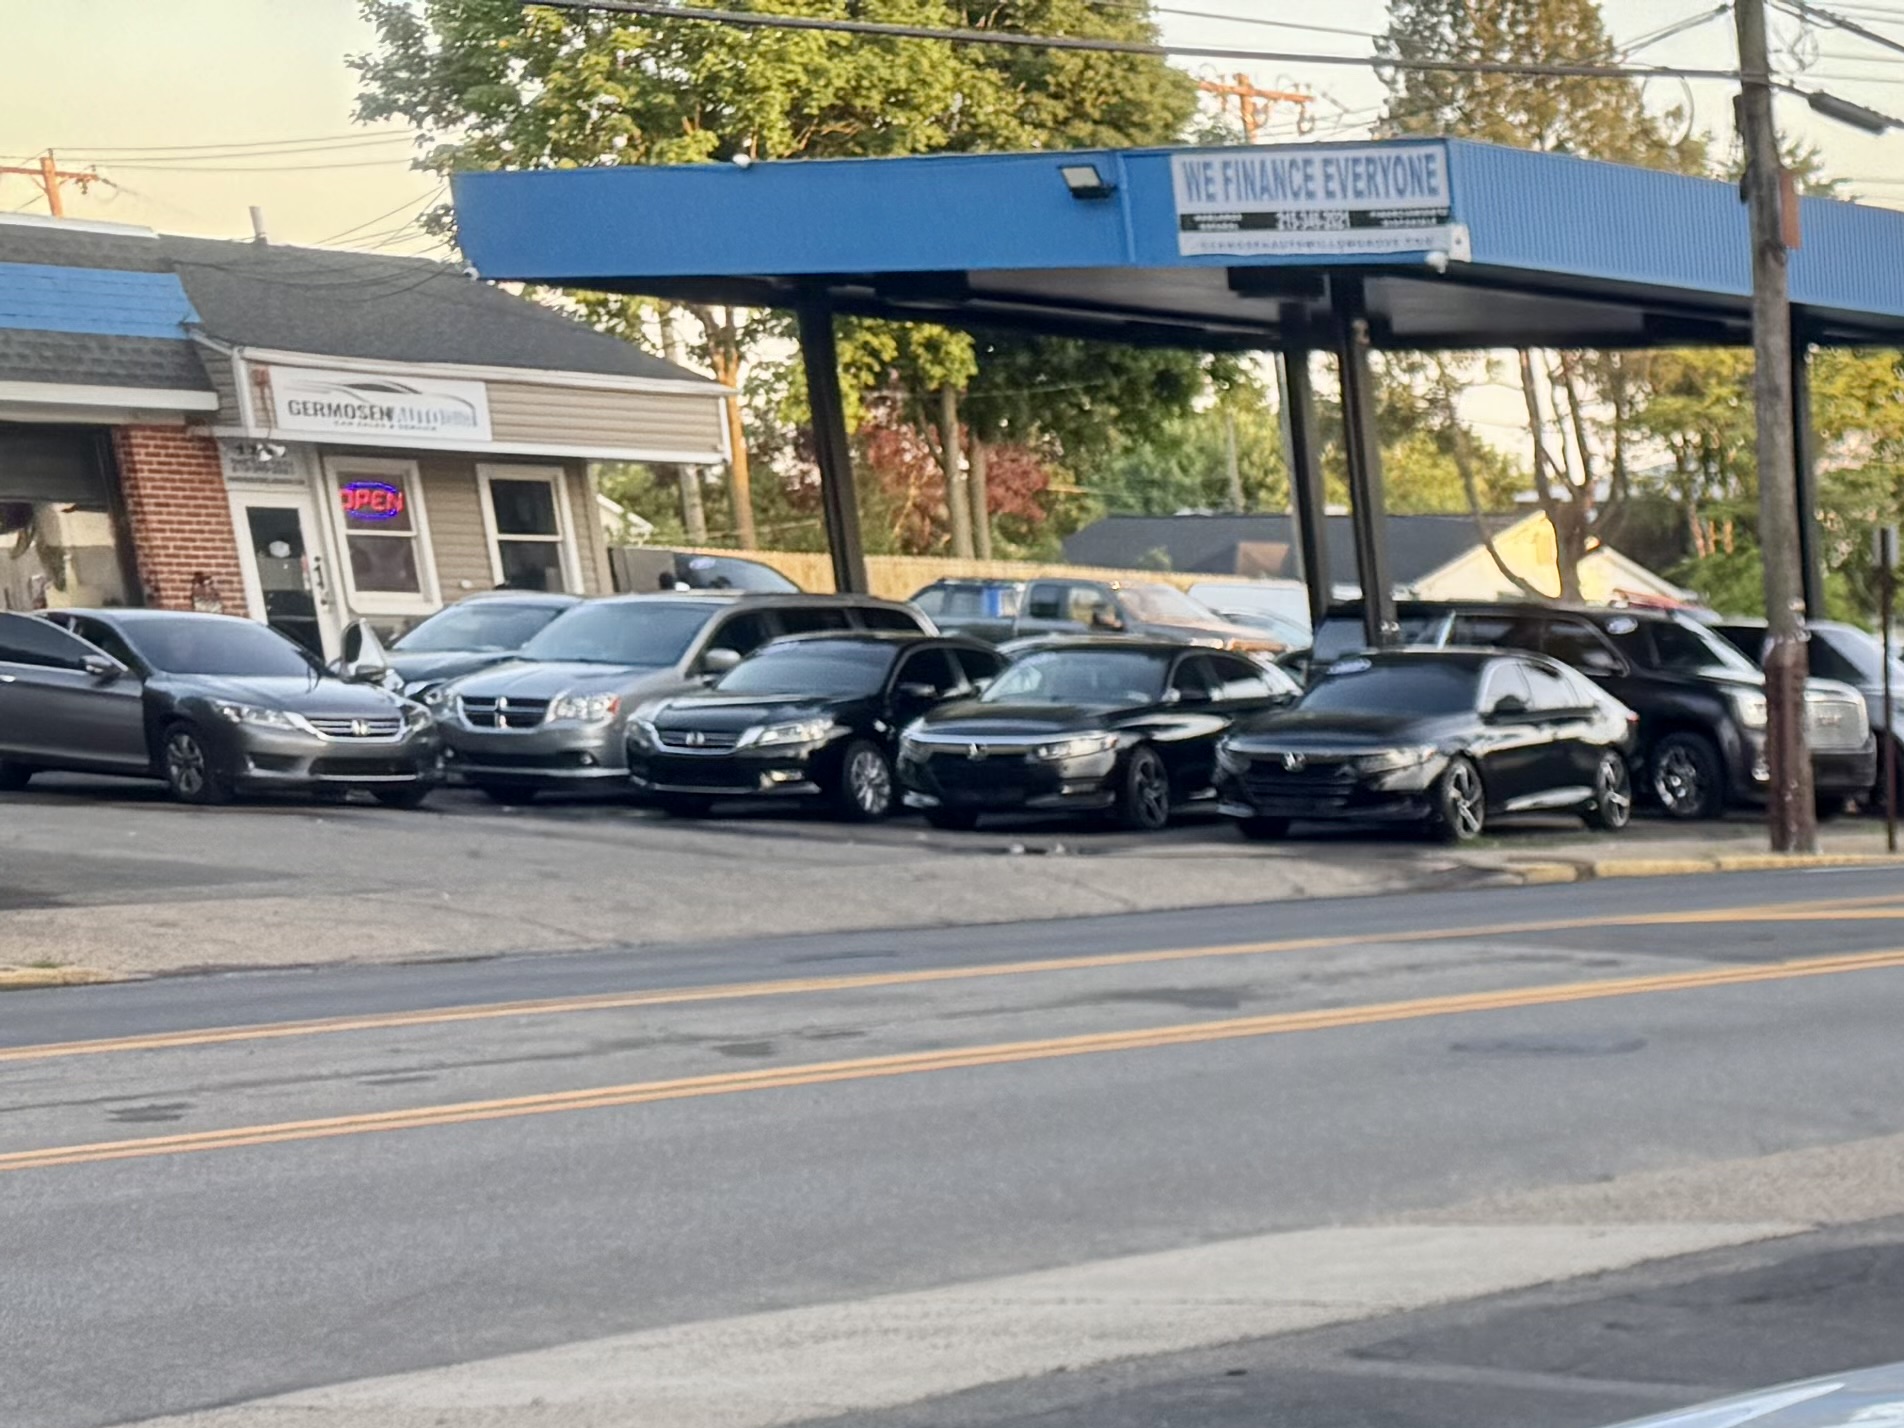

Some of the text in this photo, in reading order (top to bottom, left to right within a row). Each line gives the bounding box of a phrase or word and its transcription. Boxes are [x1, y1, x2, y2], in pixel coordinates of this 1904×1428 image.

[1182, 153, 1439, 201] WE FINANCE EVERYONE
[338, 488, 404, 513] OPEN
